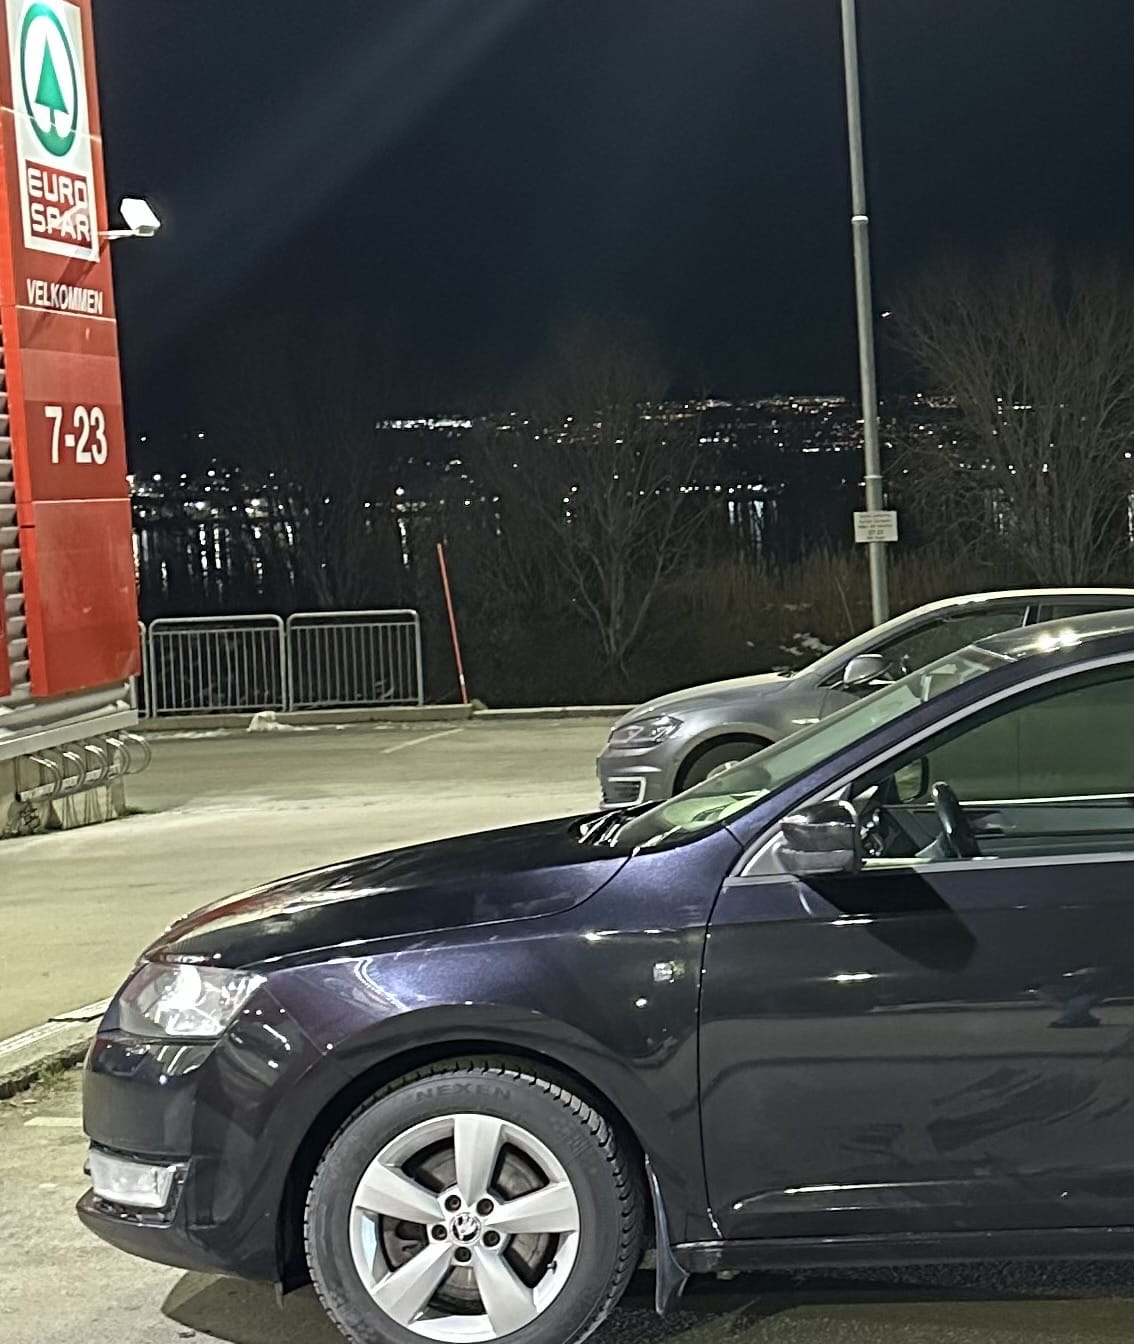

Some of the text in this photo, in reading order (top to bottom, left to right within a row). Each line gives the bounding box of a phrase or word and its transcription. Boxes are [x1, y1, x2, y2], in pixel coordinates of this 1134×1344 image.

[27, 167, 88, 209] EURO
[30, 202, 91, 242] SPAR
[26, 278, 103, 315] VELKOMMEN
[44, 405, 108, 465] 7-23
[415, 1083, 511, 1102] NEXEN
